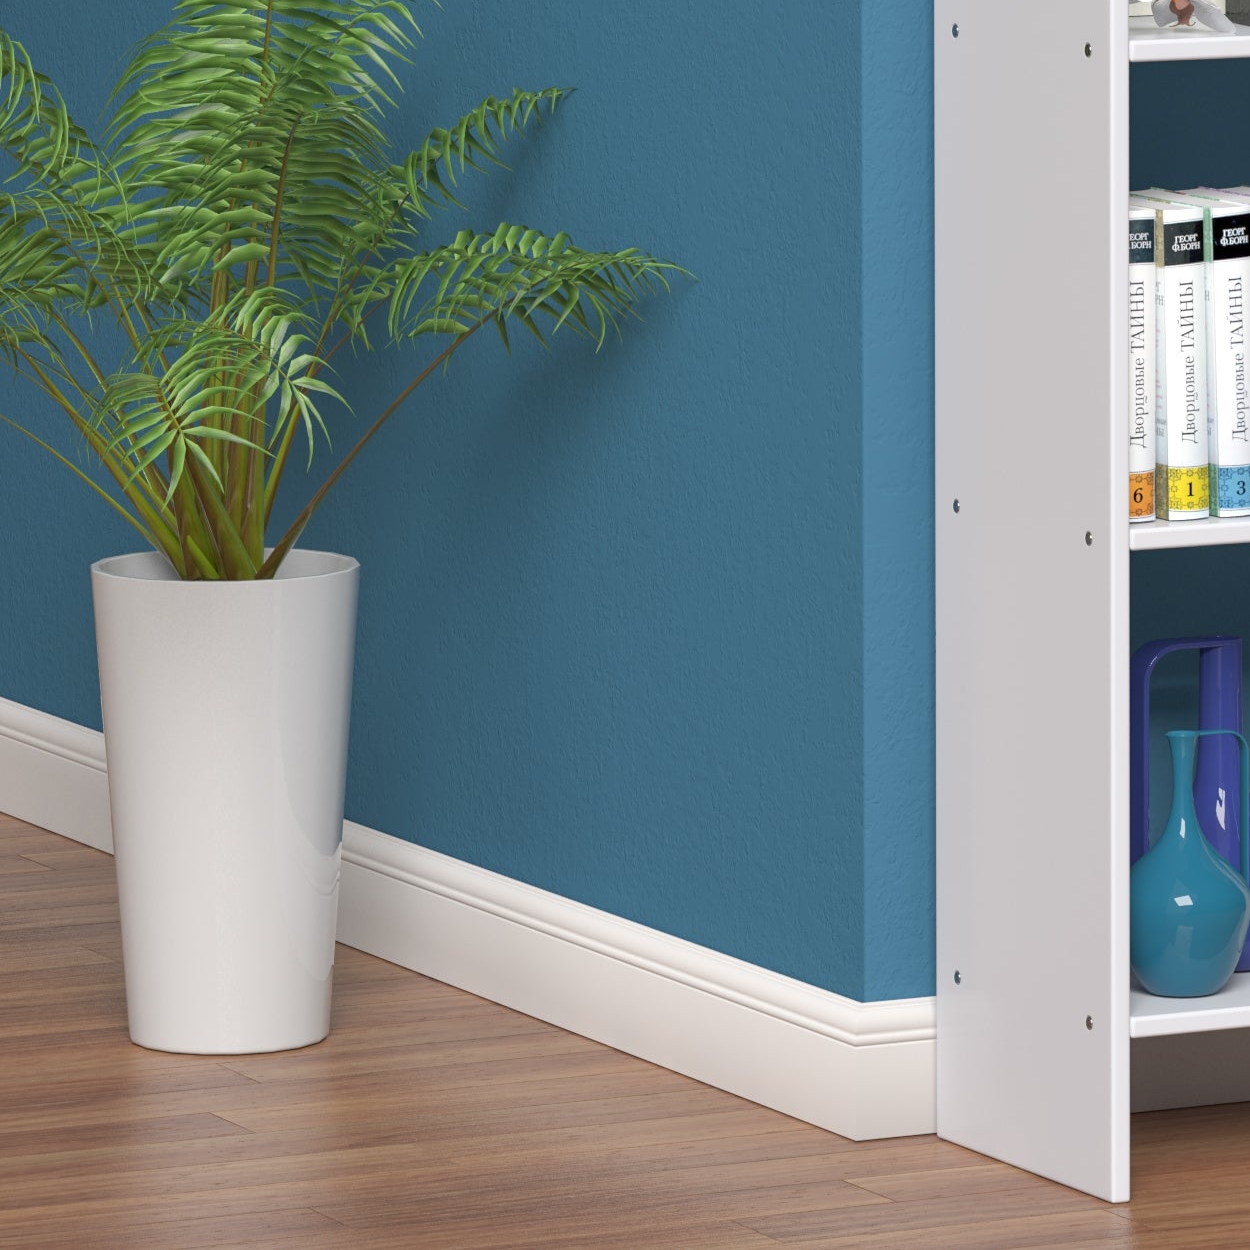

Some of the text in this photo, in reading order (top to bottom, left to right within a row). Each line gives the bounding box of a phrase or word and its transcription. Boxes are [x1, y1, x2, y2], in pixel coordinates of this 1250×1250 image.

[1174, 234, 1199, 244] ГЕОРГ
[1222, 227, 1246, 238] ГЕОРГ
[1133, 487, 1143, 503] 6
[1186, 482, 1194, 497] 1
[1236, 480, 1246, 495] 3
